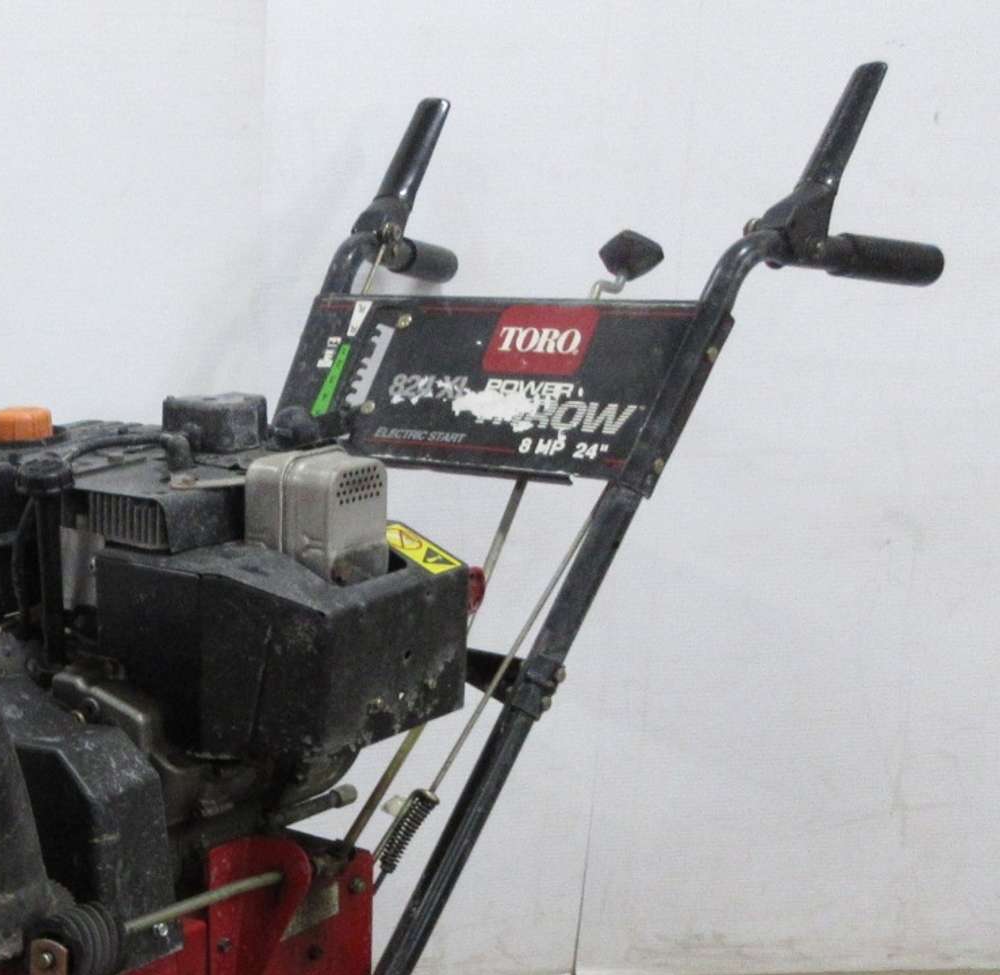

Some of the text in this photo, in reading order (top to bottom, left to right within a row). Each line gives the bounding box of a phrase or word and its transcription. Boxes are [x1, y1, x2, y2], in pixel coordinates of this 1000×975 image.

[498, 326, 582, 355] TORO
[484, 378, 574, 399] POWER
[374, 426, 467, 443] ELECTRIC START
[572, 442, 609, 460] 24"
